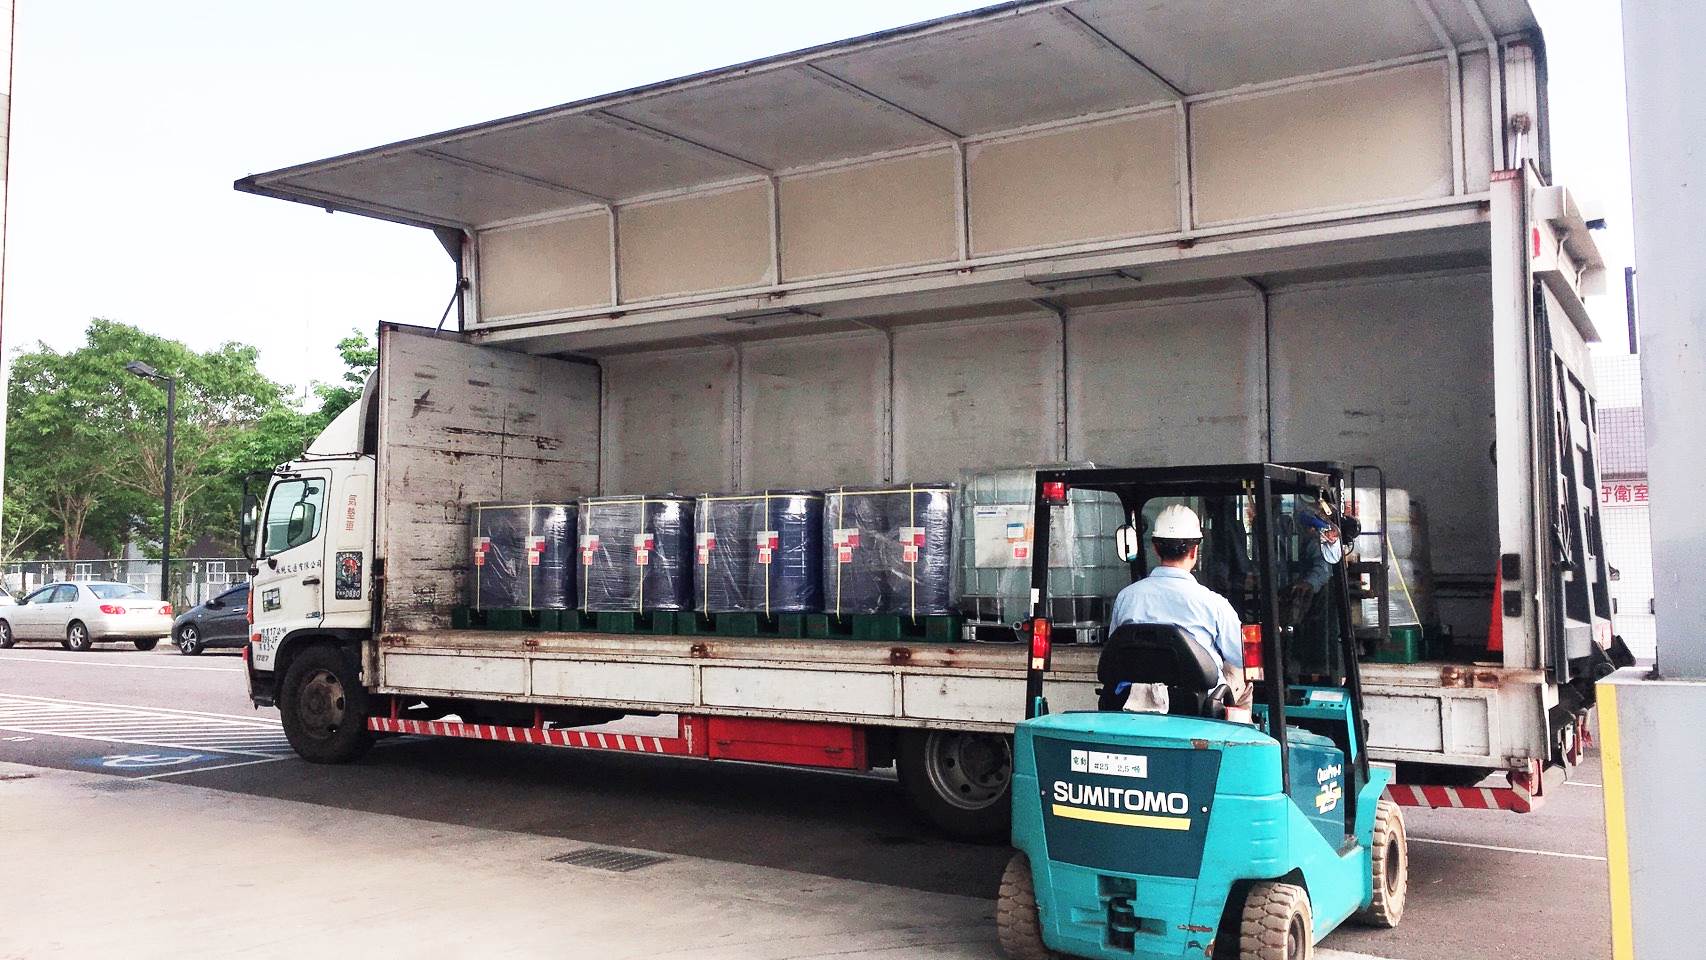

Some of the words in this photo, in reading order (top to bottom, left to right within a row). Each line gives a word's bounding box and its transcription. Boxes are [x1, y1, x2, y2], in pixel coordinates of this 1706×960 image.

[1601, 484, 1648, 502] 守衛室
[1053, 780, 1189, 815] SUMITOMO
